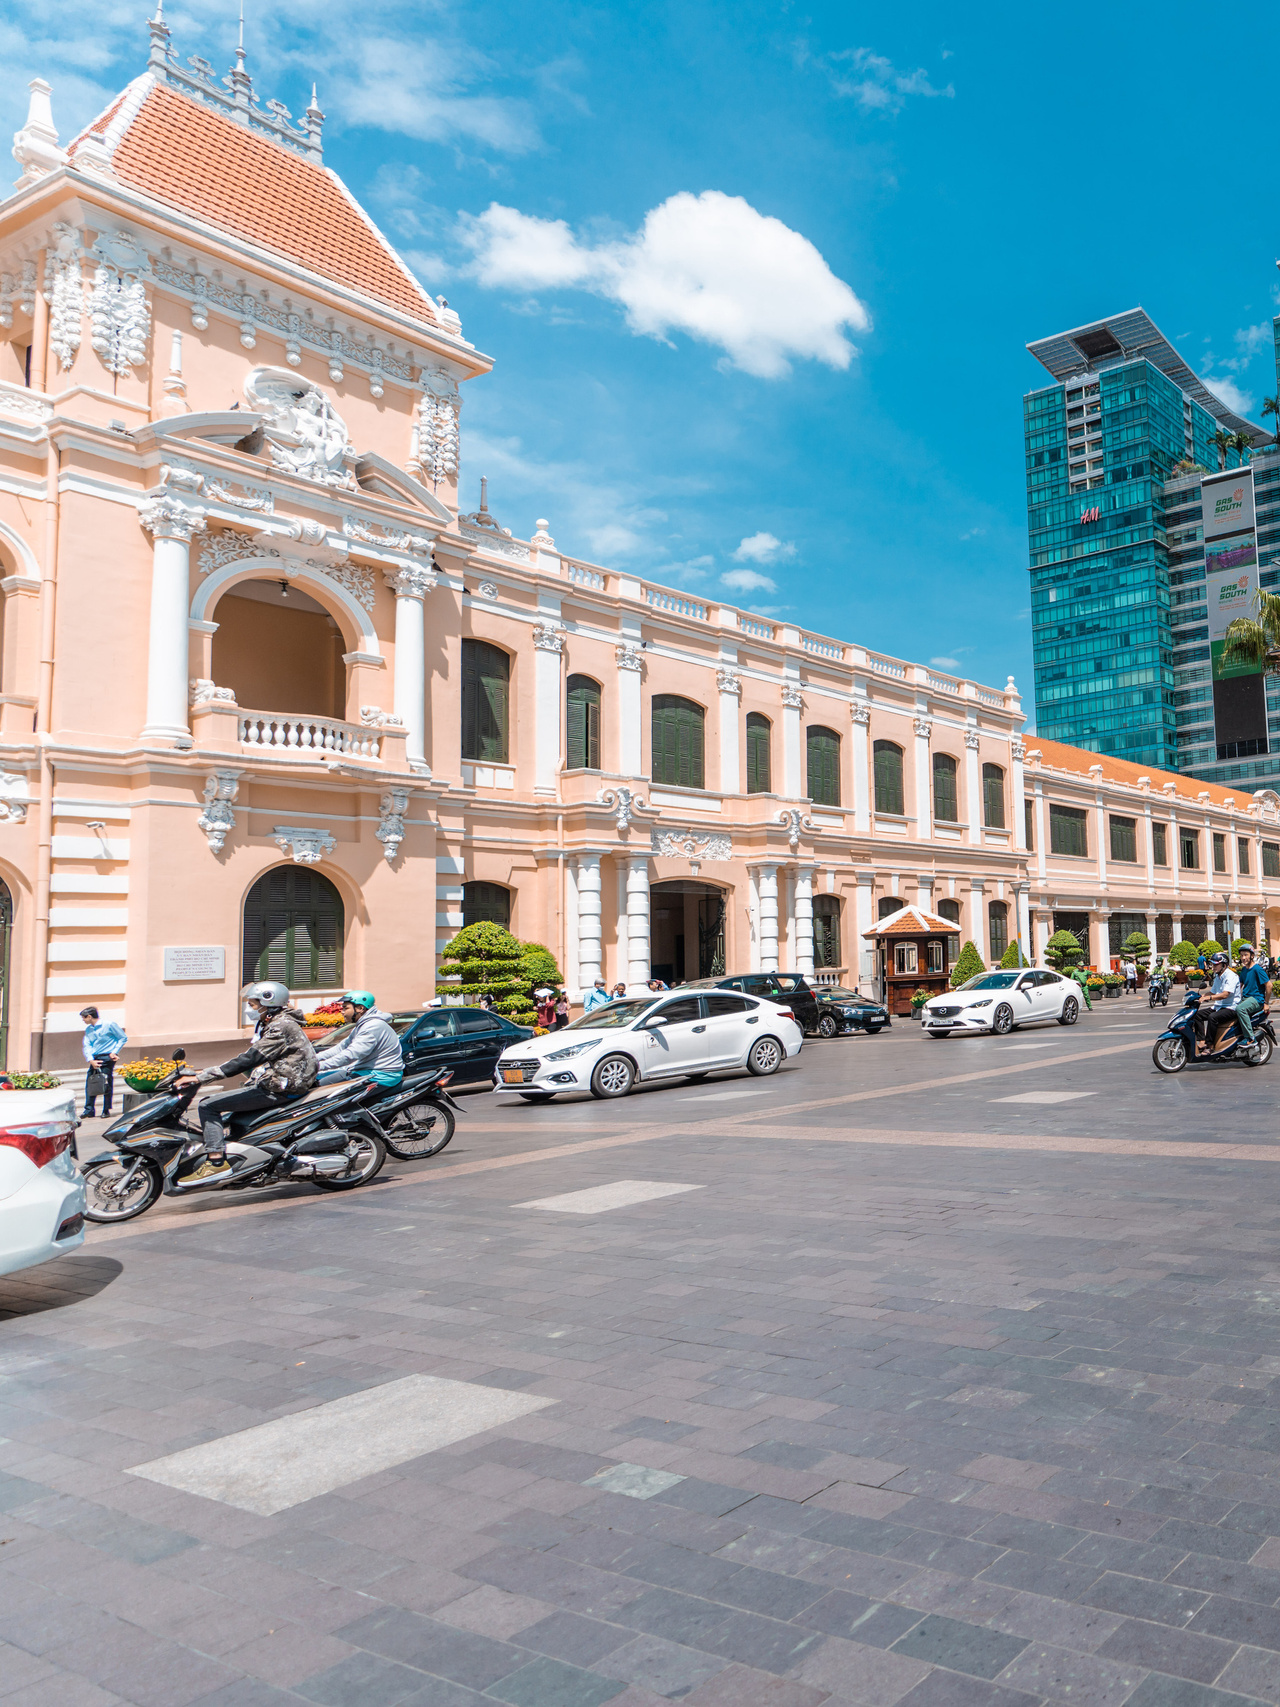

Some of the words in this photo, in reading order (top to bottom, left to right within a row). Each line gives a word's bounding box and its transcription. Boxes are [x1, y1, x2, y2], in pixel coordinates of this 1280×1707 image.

[1216, 496, 1233, 506] GAS
[1214, 502, 1242, 513] SOUTH
[1220, 583, 1238, 593] GAS
[1219, 589, 1247, 600] SOUTH
